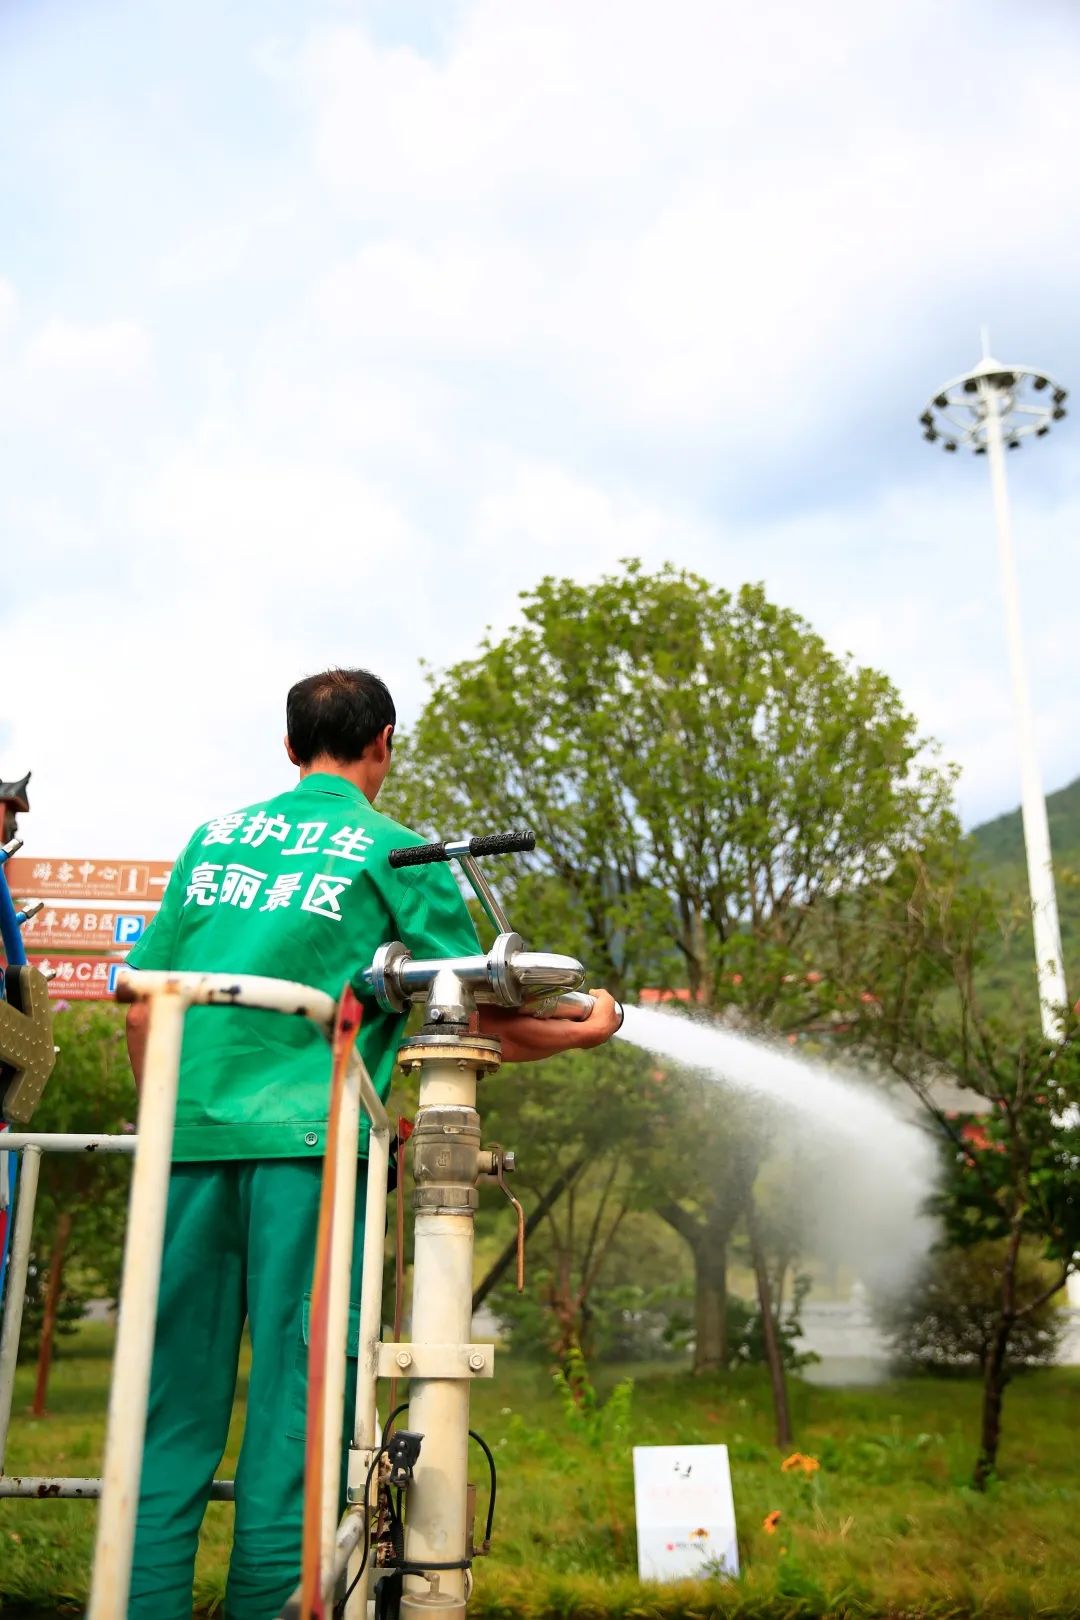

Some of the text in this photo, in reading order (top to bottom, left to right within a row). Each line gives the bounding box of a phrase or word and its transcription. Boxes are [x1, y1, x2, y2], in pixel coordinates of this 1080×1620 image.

[201, 811, 375, 862] 爱护卫生
[32, 861, 118, 882] 游客中心
[183, 861, 353, 921] 亮丽景区
[119, 918, 140, 942] P
[26, 959, 109, 981] 车场C区
